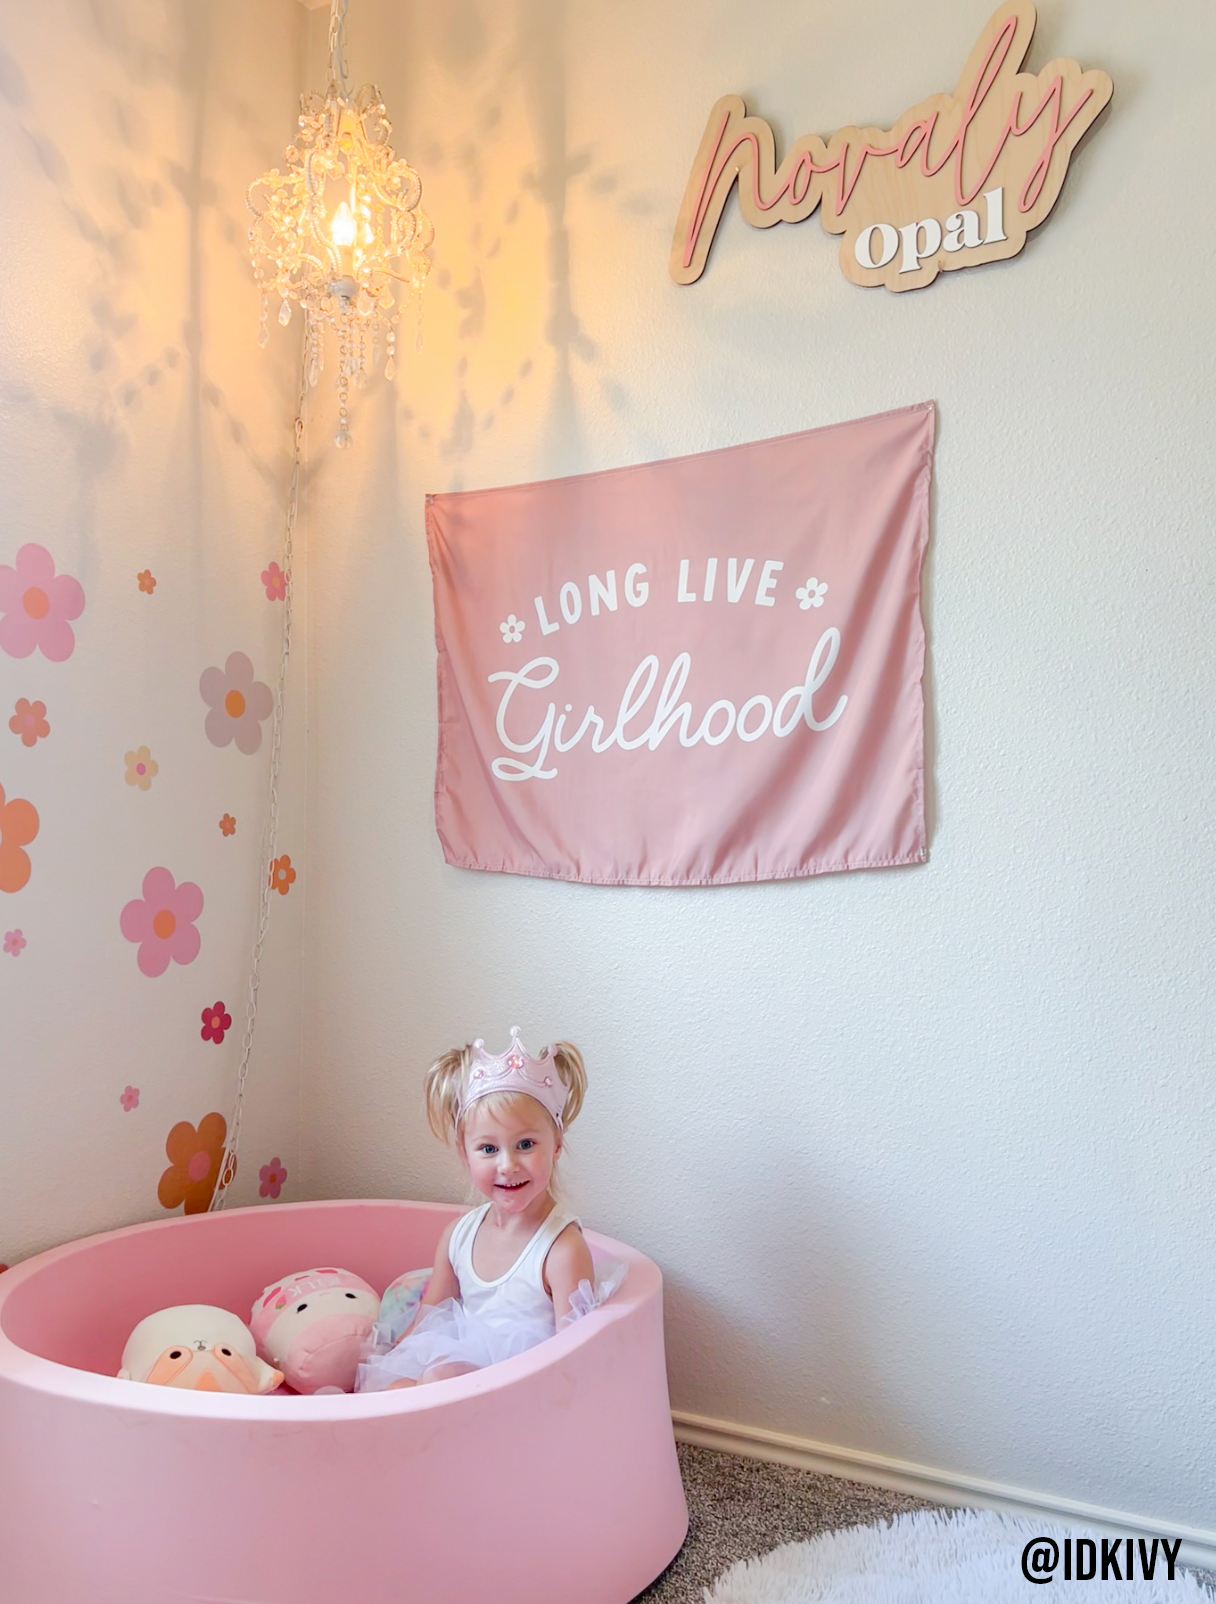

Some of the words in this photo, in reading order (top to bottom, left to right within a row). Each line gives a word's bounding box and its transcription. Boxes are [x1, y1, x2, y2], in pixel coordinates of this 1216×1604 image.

[854, 186, 1008, 273] opal
[534, 562, 649, 636] LONG
[677, 557, 784, 607] LIVE
[487, 626, 849, 782] Girlhood
